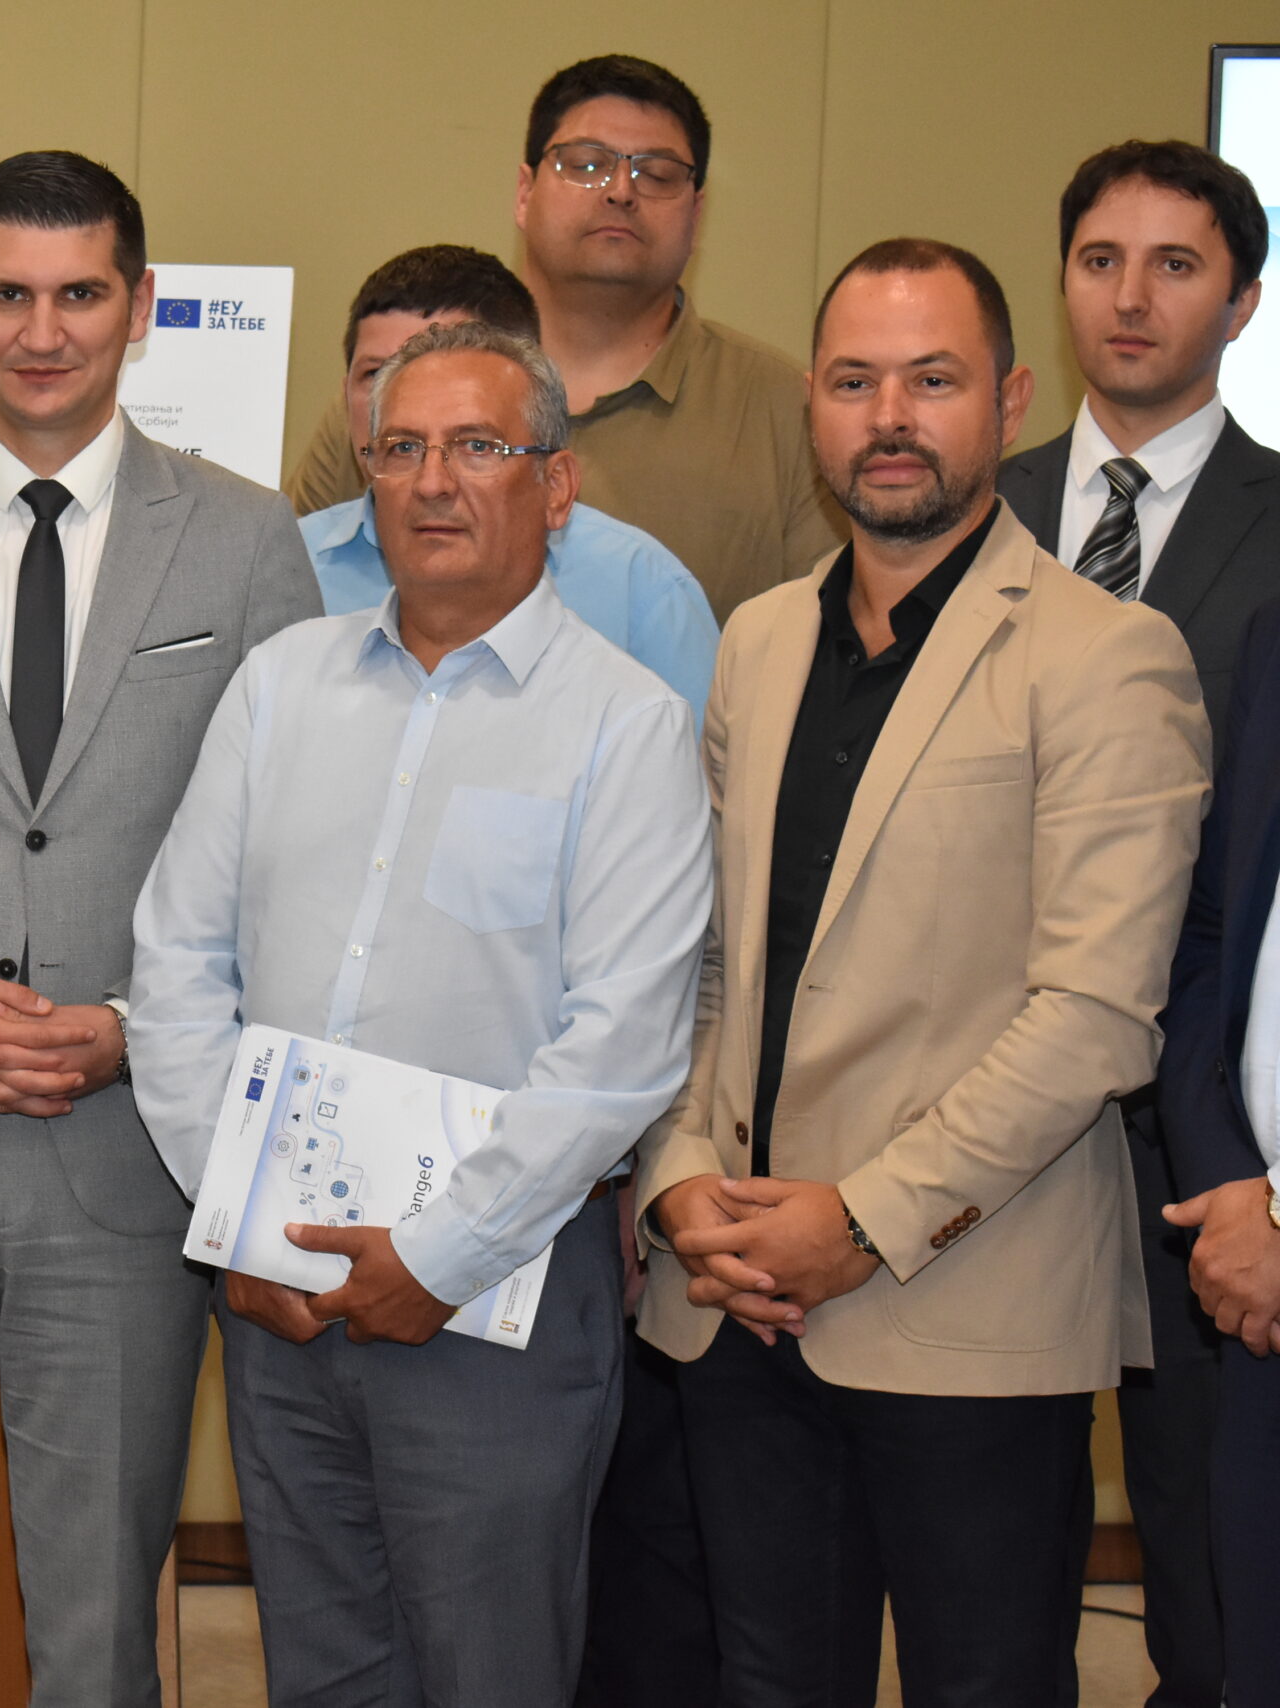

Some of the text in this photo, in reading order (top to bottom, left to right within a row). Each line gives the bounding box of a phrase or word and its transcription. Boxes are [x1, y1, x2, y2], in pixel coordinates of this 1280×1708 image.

[208, 300, 243, 316] #ЕУ
[207, 317, 266, 331] ЗА ТЕБЕ
